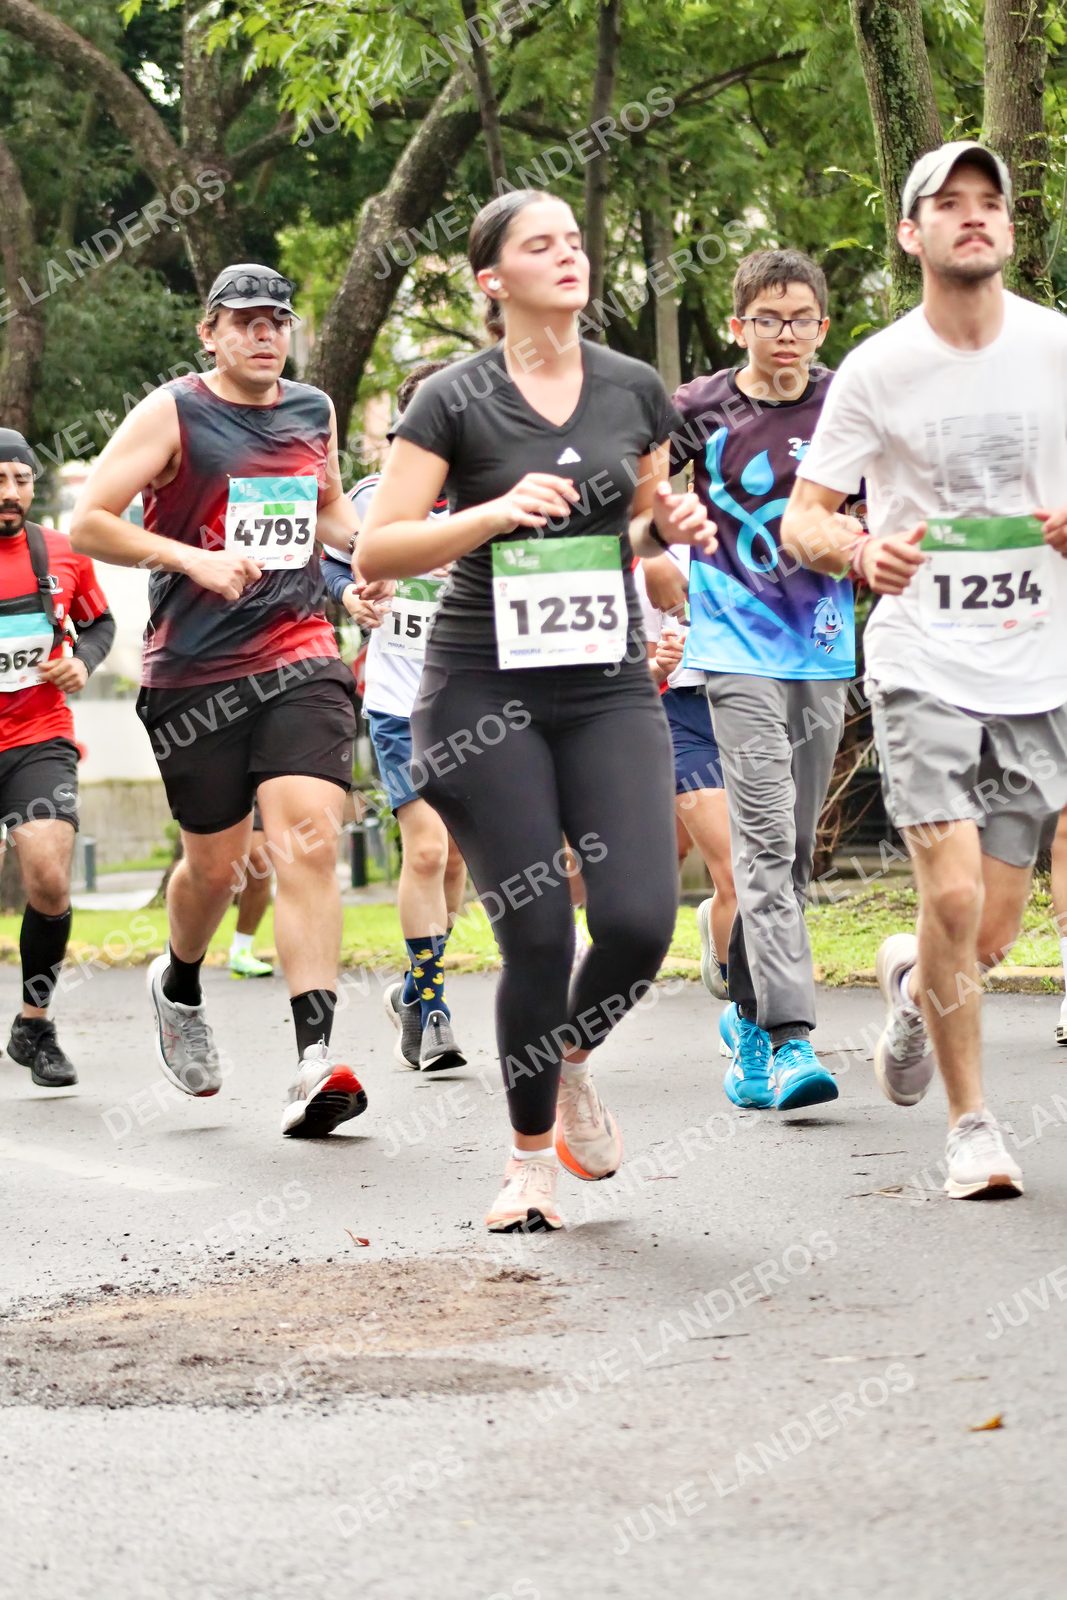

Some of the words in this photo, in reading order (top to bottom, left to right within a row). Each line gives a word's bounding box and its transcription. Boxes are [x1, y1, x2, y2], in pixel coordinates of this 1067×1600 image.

[233, 517, 311, 547] 4793
[933, 569, 1042, 609] 1234
[391, 610, 431, 639] 15
[509, 594, 619, 636] 1233
